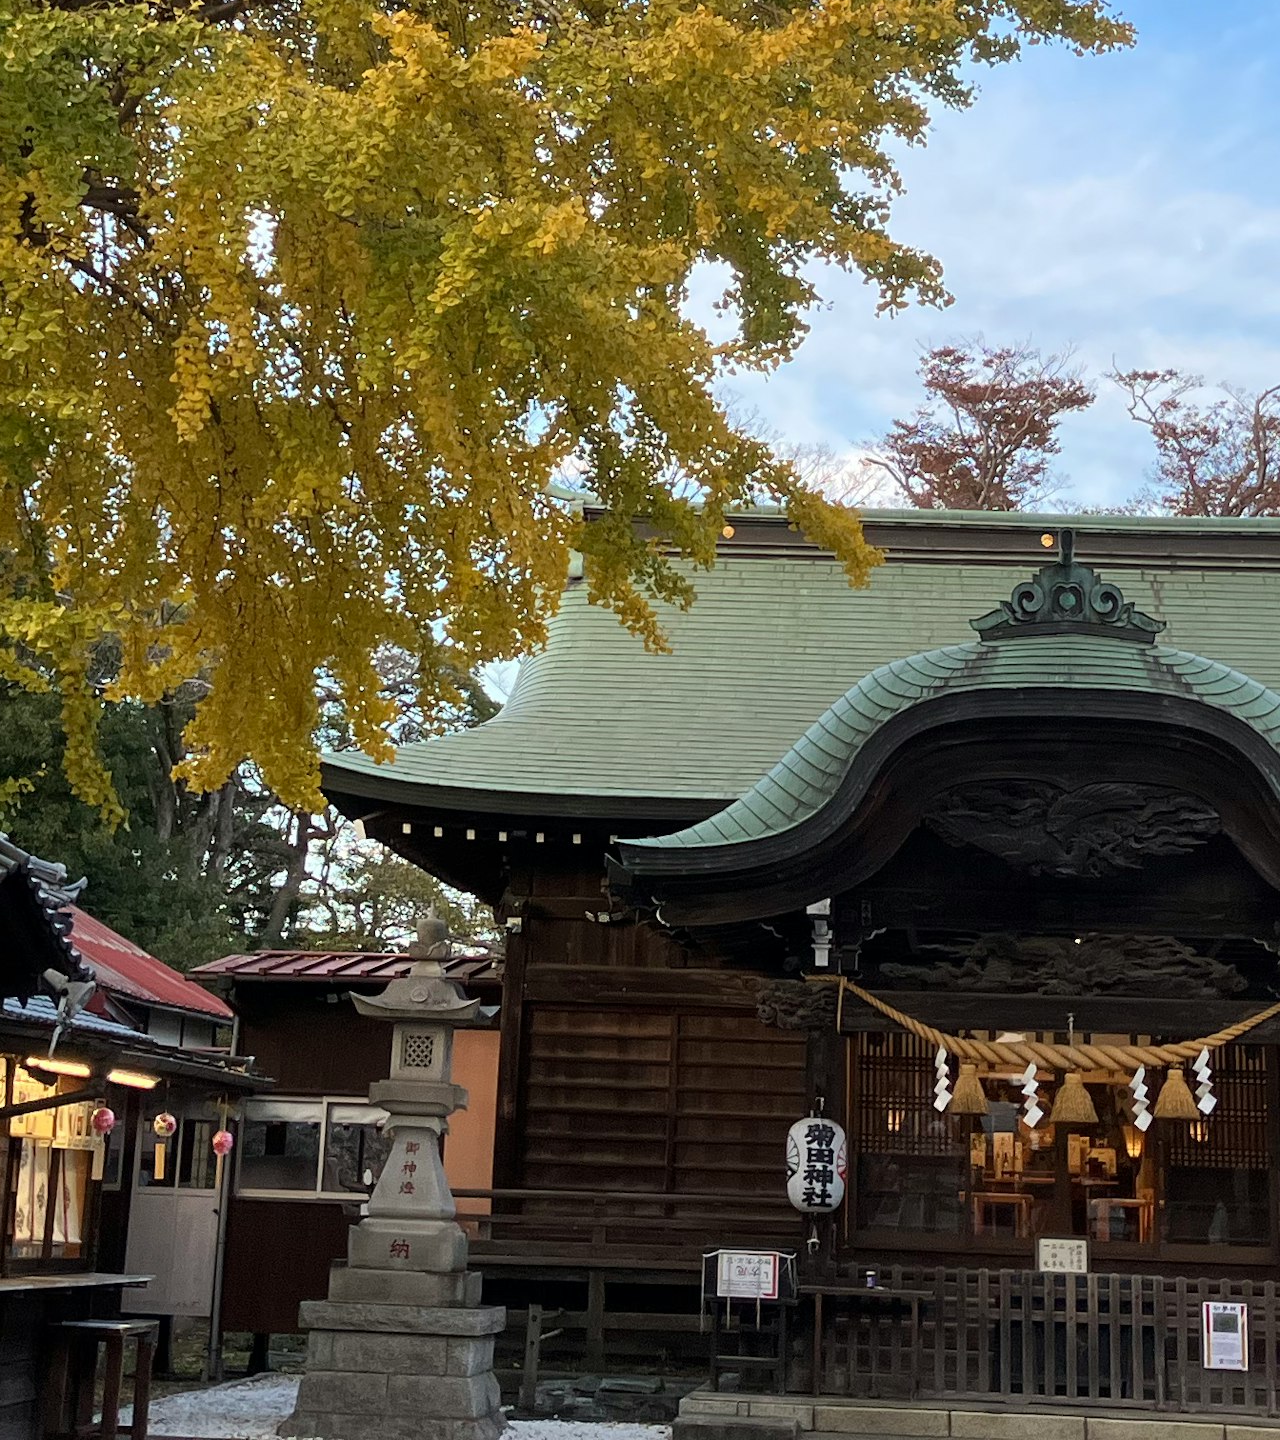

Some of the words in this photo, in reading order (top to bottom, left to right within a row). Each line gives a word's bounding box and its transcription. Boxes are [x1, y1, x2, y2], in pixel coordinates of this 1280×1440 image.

[801, 1123, 835, 1207] 菊田神社
[389, 1238, 410, 1260] 納
